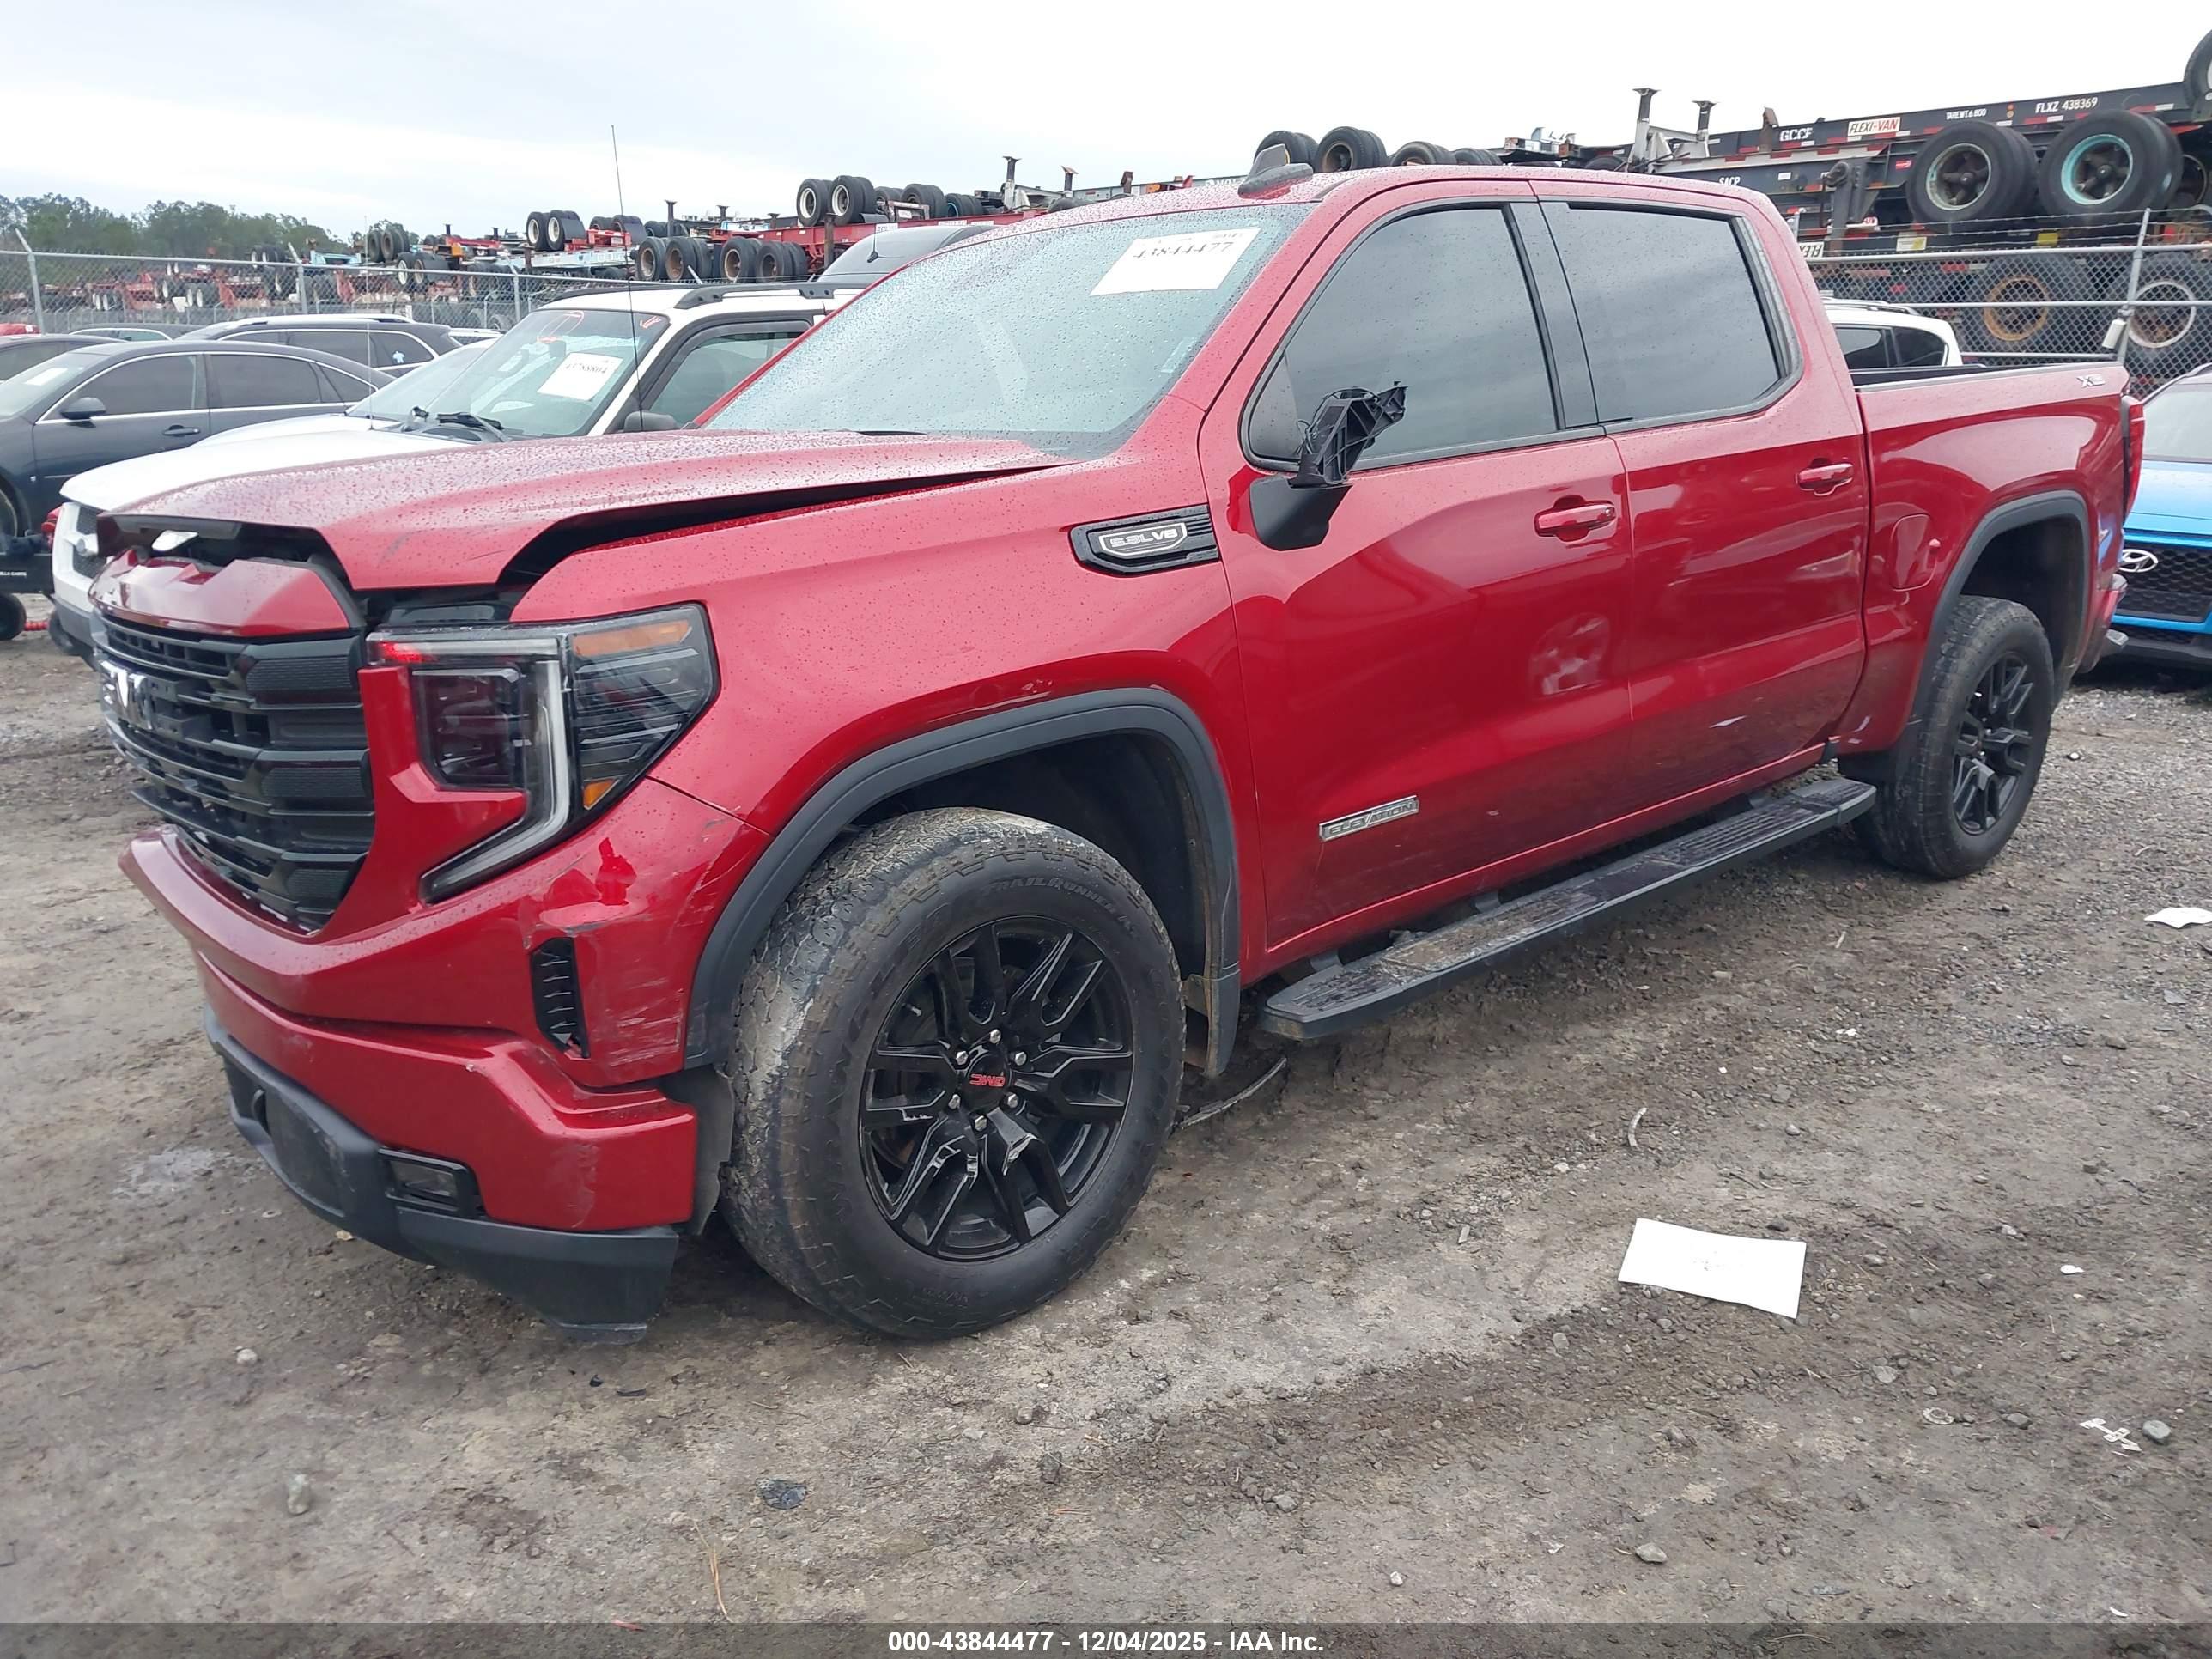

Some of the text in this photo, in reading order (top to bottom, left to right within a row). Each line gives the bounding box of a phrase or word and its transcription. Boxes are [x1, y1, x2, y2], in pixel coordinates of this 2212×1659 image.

[2062, 97, 2099, 110] 438369
[1849, 118, 1898, 133] FLEXI-VAN
[1329, 802, 1413, 835] ELEVATION
